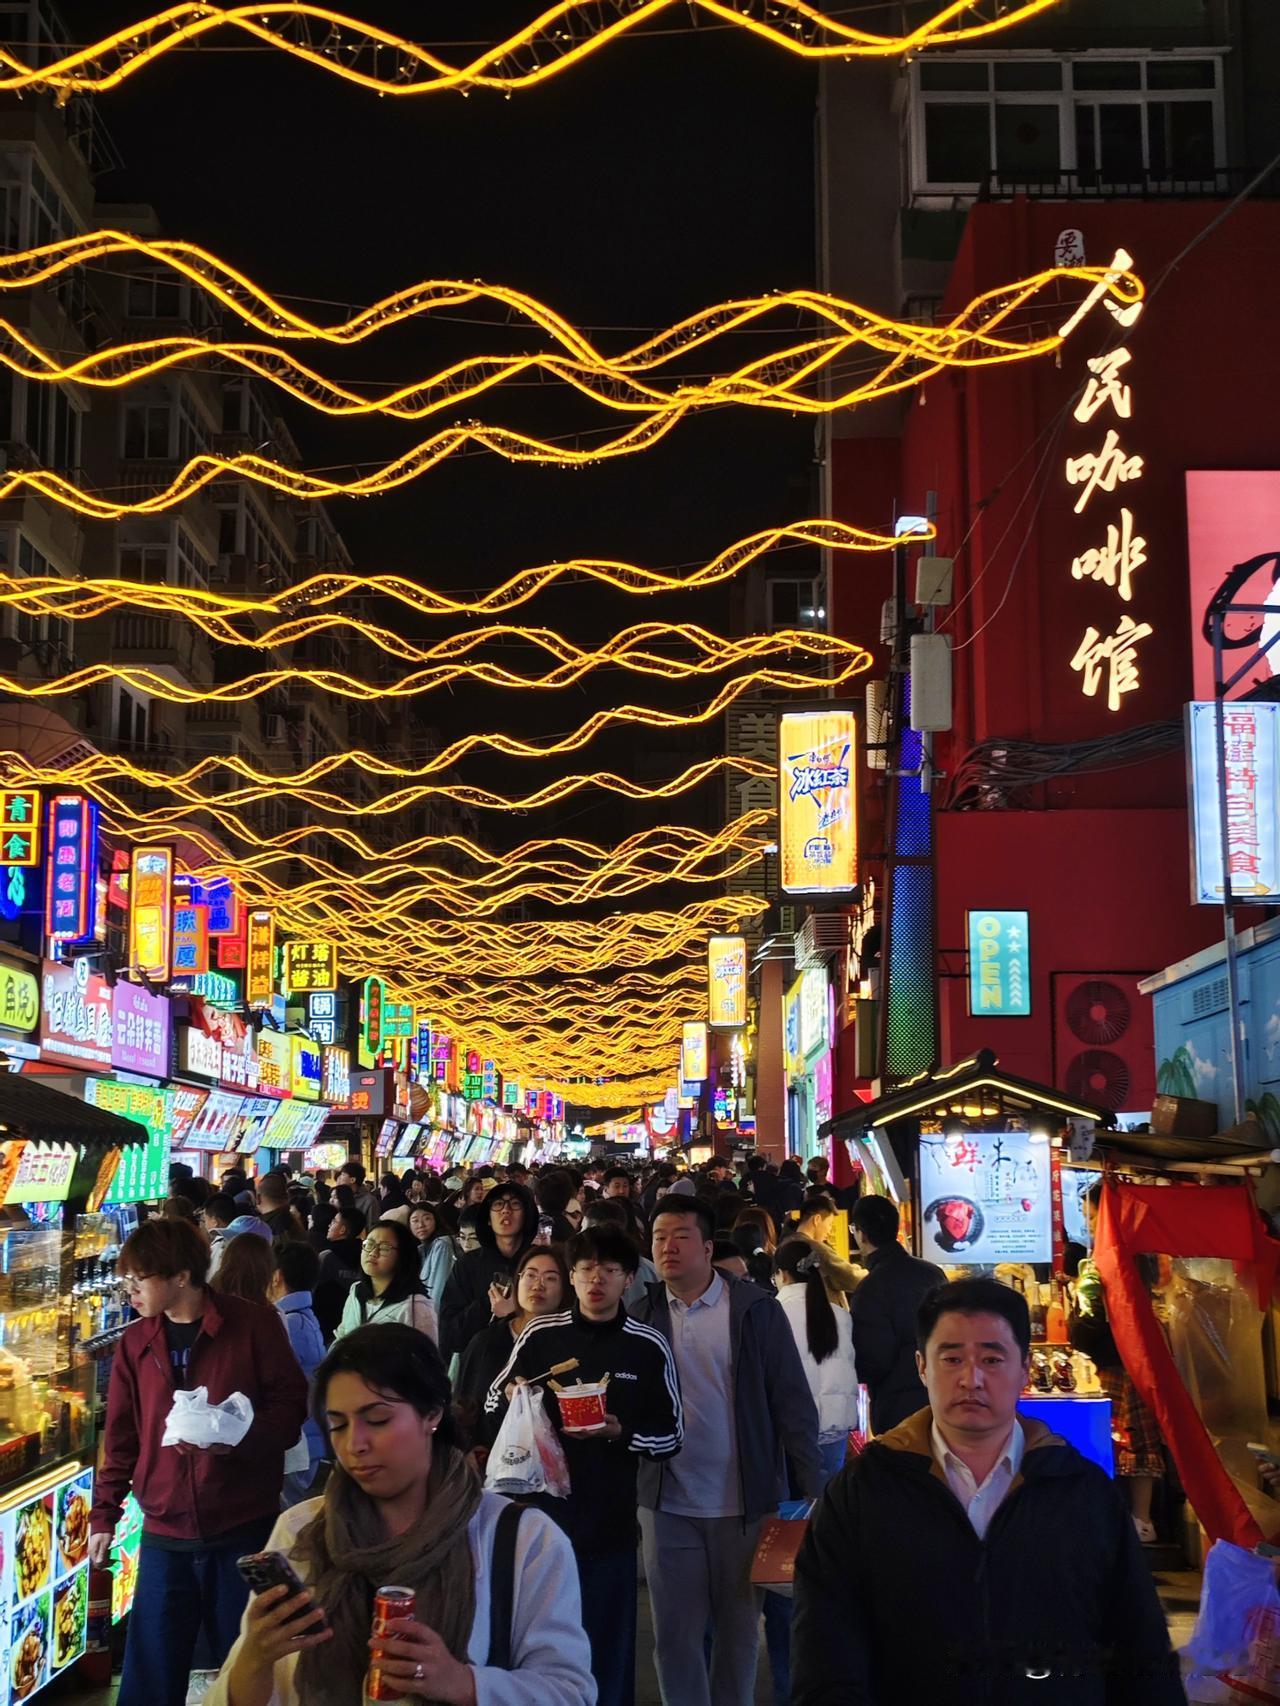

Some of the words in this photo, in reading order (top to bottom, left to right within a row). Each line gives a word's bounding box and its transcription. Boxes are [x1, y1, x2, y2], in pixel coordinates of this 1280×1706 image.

[1058, 248, 1153, 711] 人民咖啡馆
[789, 766, 849, 803] 冰红茶
[3, 795, 33, 859] 青食
[251, 926, 271, 994] 谦祥益
[291, 943, 330, 963] 灯塔
[977, 916, 1002, 1009] OPEN
[291, 969, 330, 988] 酱油
[614, 1371, 638, 1381] adidas
